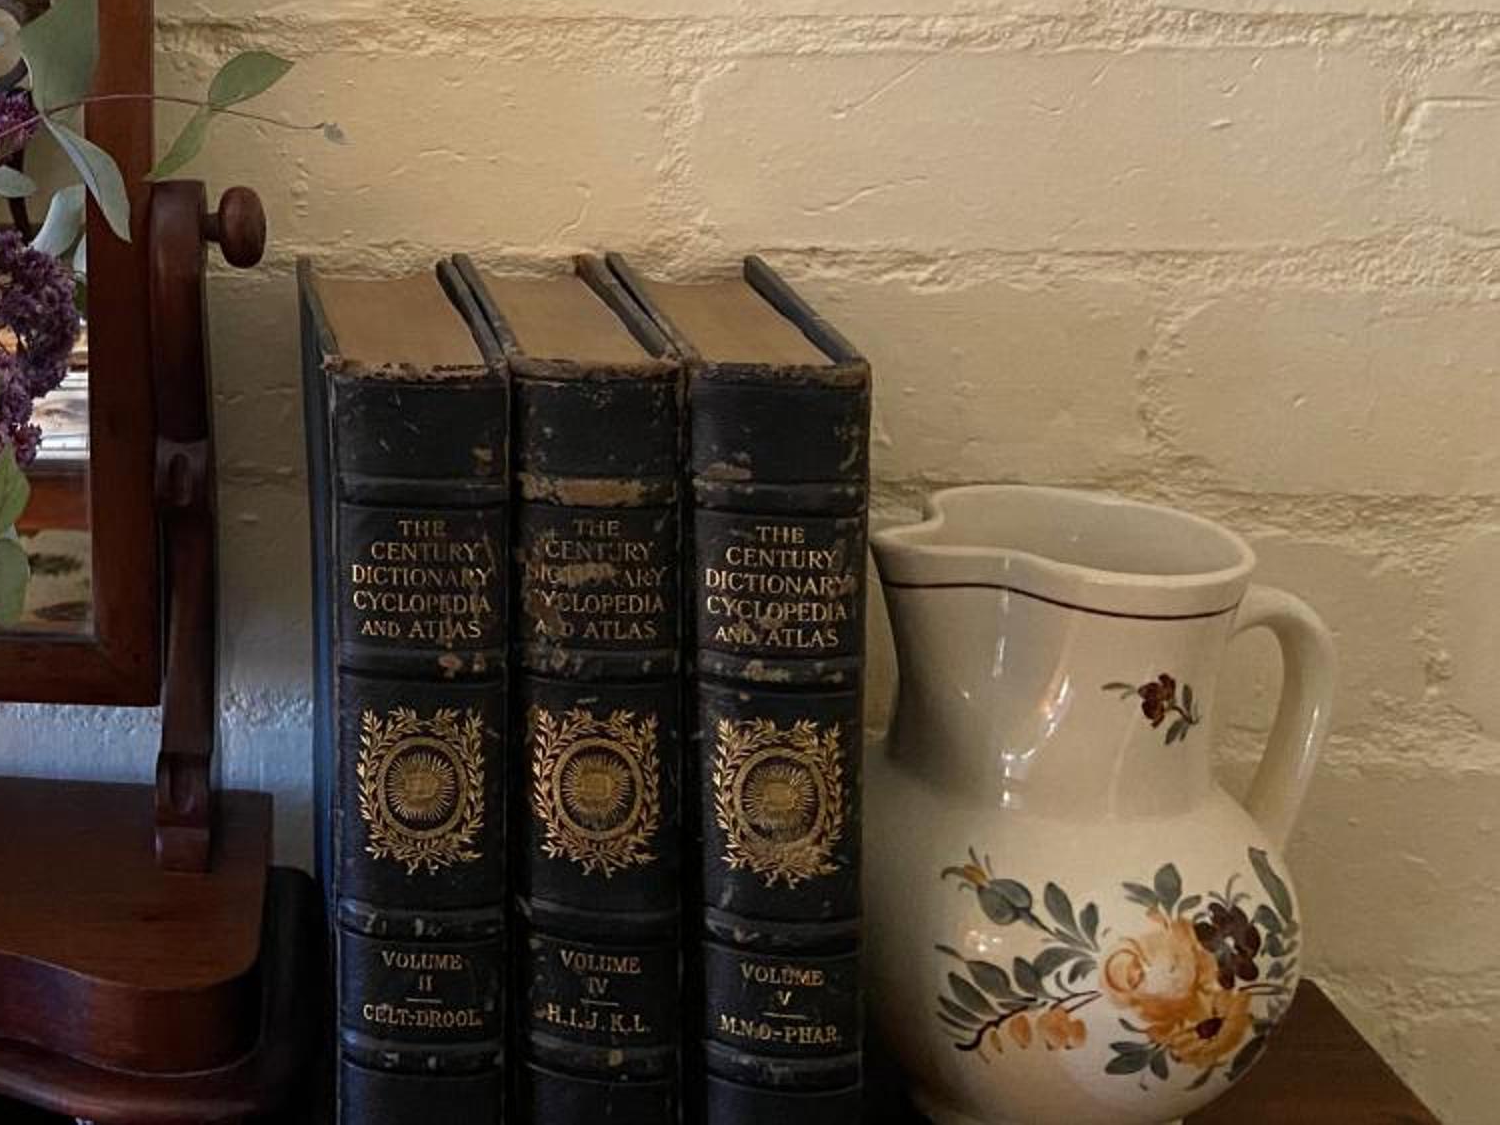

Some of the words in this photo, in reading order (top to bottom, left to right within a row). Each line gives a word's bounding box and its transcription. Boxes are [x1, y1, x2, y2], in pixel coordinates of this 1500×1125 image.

[398, 520, 447, 537] THE
[573, 519, 621, 537] THE
[756, 526, 805, 544] THE
[371, 541, 483, 562] CENTURY
[545, 540, 654, 561] CENTURY
[725, 546, 837, 569] CENTURY
[351, 564, 492, 587] DICTIONARY
[705, 567, 851, 595] DICTIONARY
[353, 590, 492, 614] CYCLOPEDIA
[707, 595, 847, 622] CYCLOPEDIA
[361, 620, 400, 638] AND
[408, 620, 482, 639] ATLAS
[583, 620, 657, 639] ATLAS
[715, 626, 757, 645] AND
[766, 628, 839, 648] ATLAS
[381, 950, 463, 970] VOLUME
[560, 949, 643, 973] VOLUME
[419, 975, 433, 992] II
[740, 962, 824, 986] VOLUME
[588, 977, 609, 994] IV
[776, 990, 793, 1006] V
